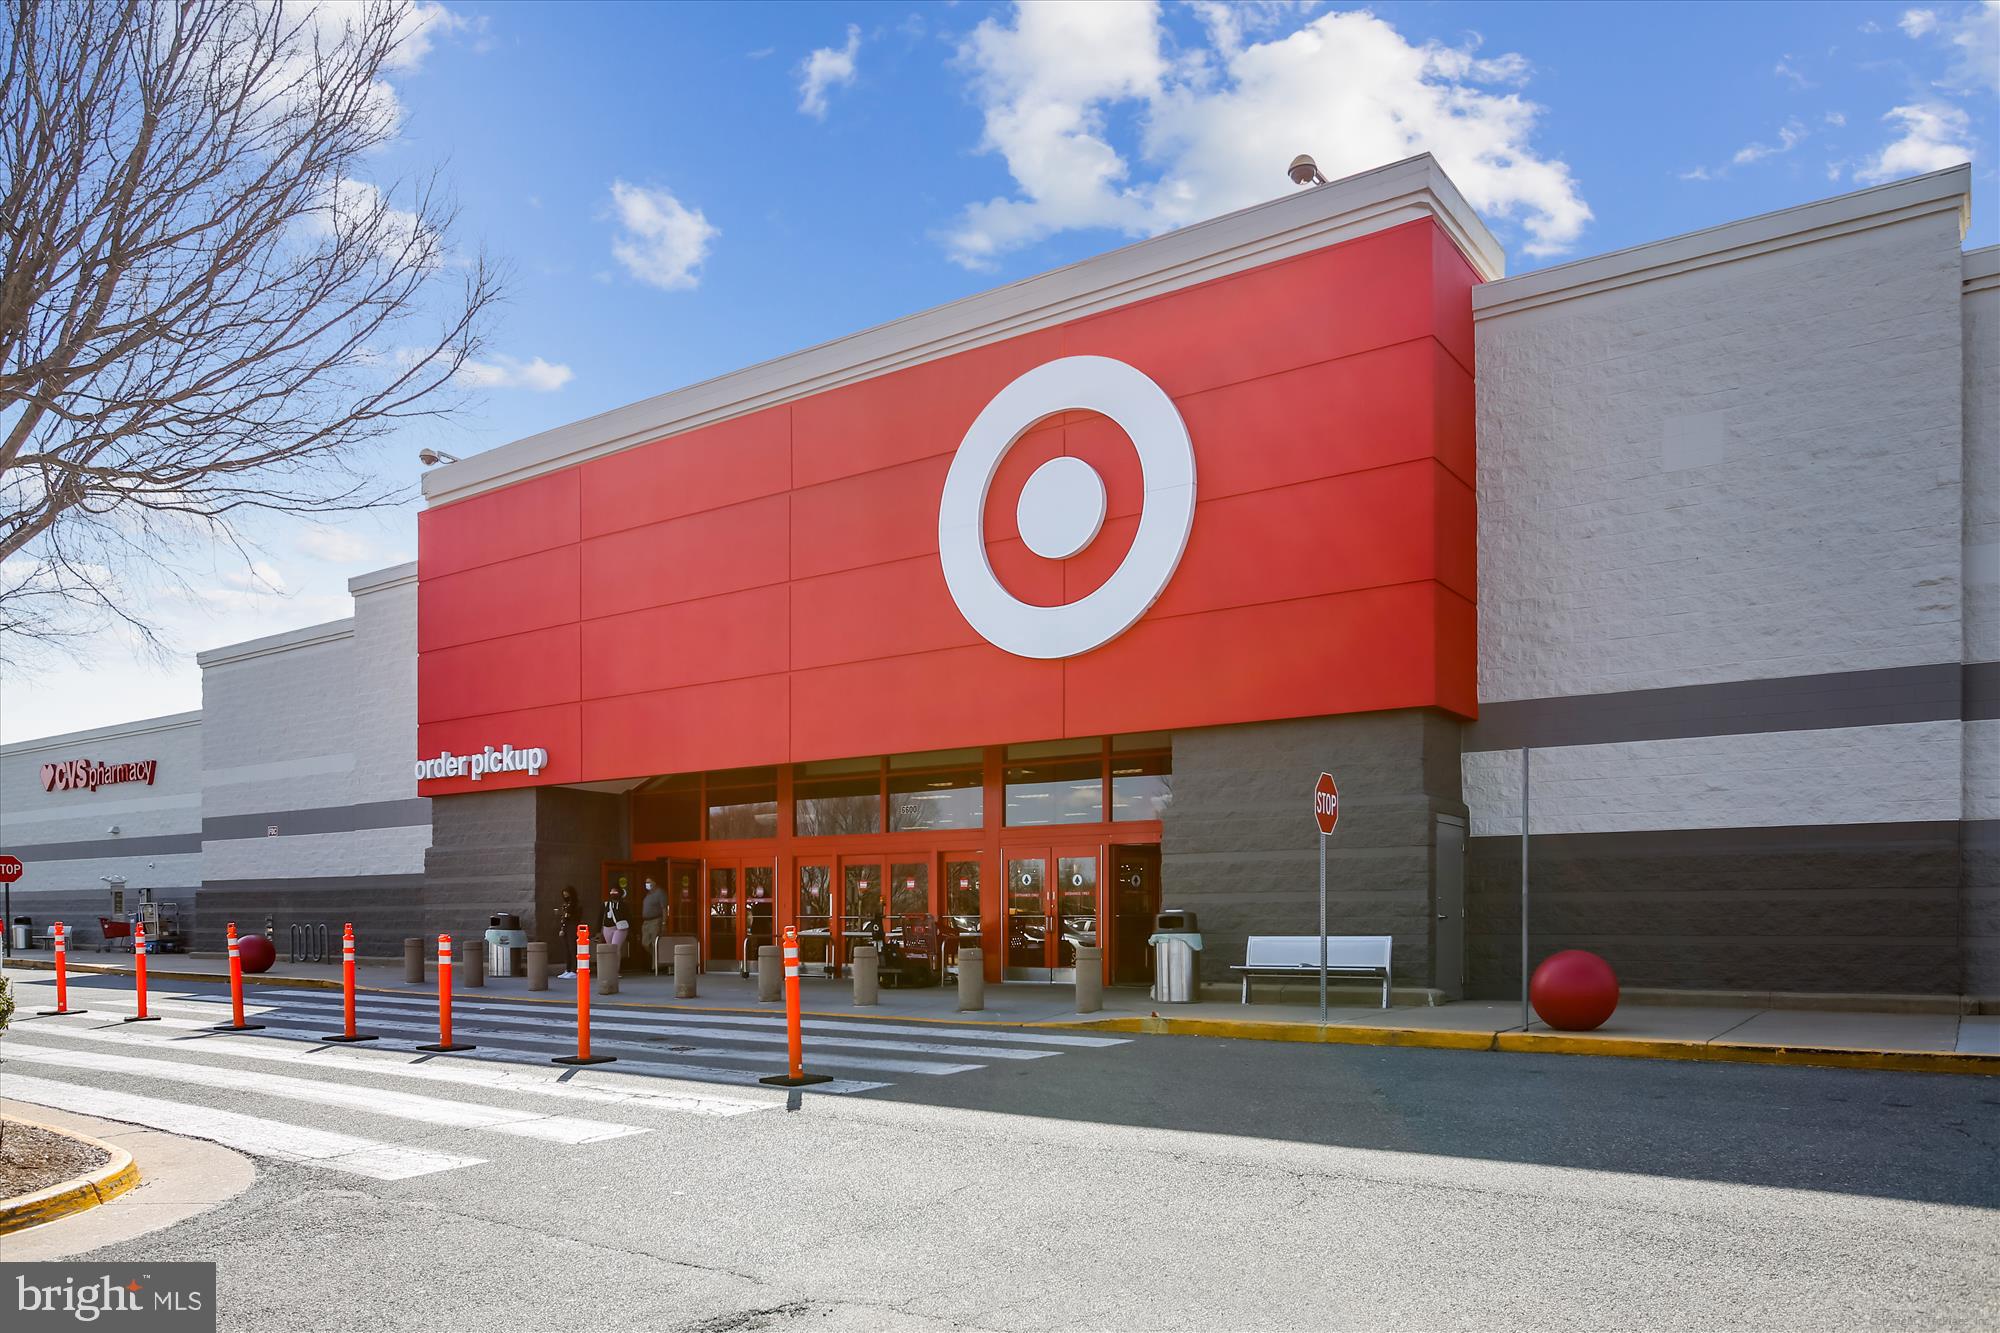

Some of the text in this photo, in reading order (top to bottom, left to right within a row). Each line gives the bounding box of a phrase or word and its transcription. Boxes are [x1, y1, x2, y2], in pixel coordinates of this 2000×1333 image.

[55, 759, 157, 792] CVS pharmacy
[414, 744, 548, 780] order pickup
[1316, 791, 1337, 816] STOP
[0, 863, 21, 875] TOP
